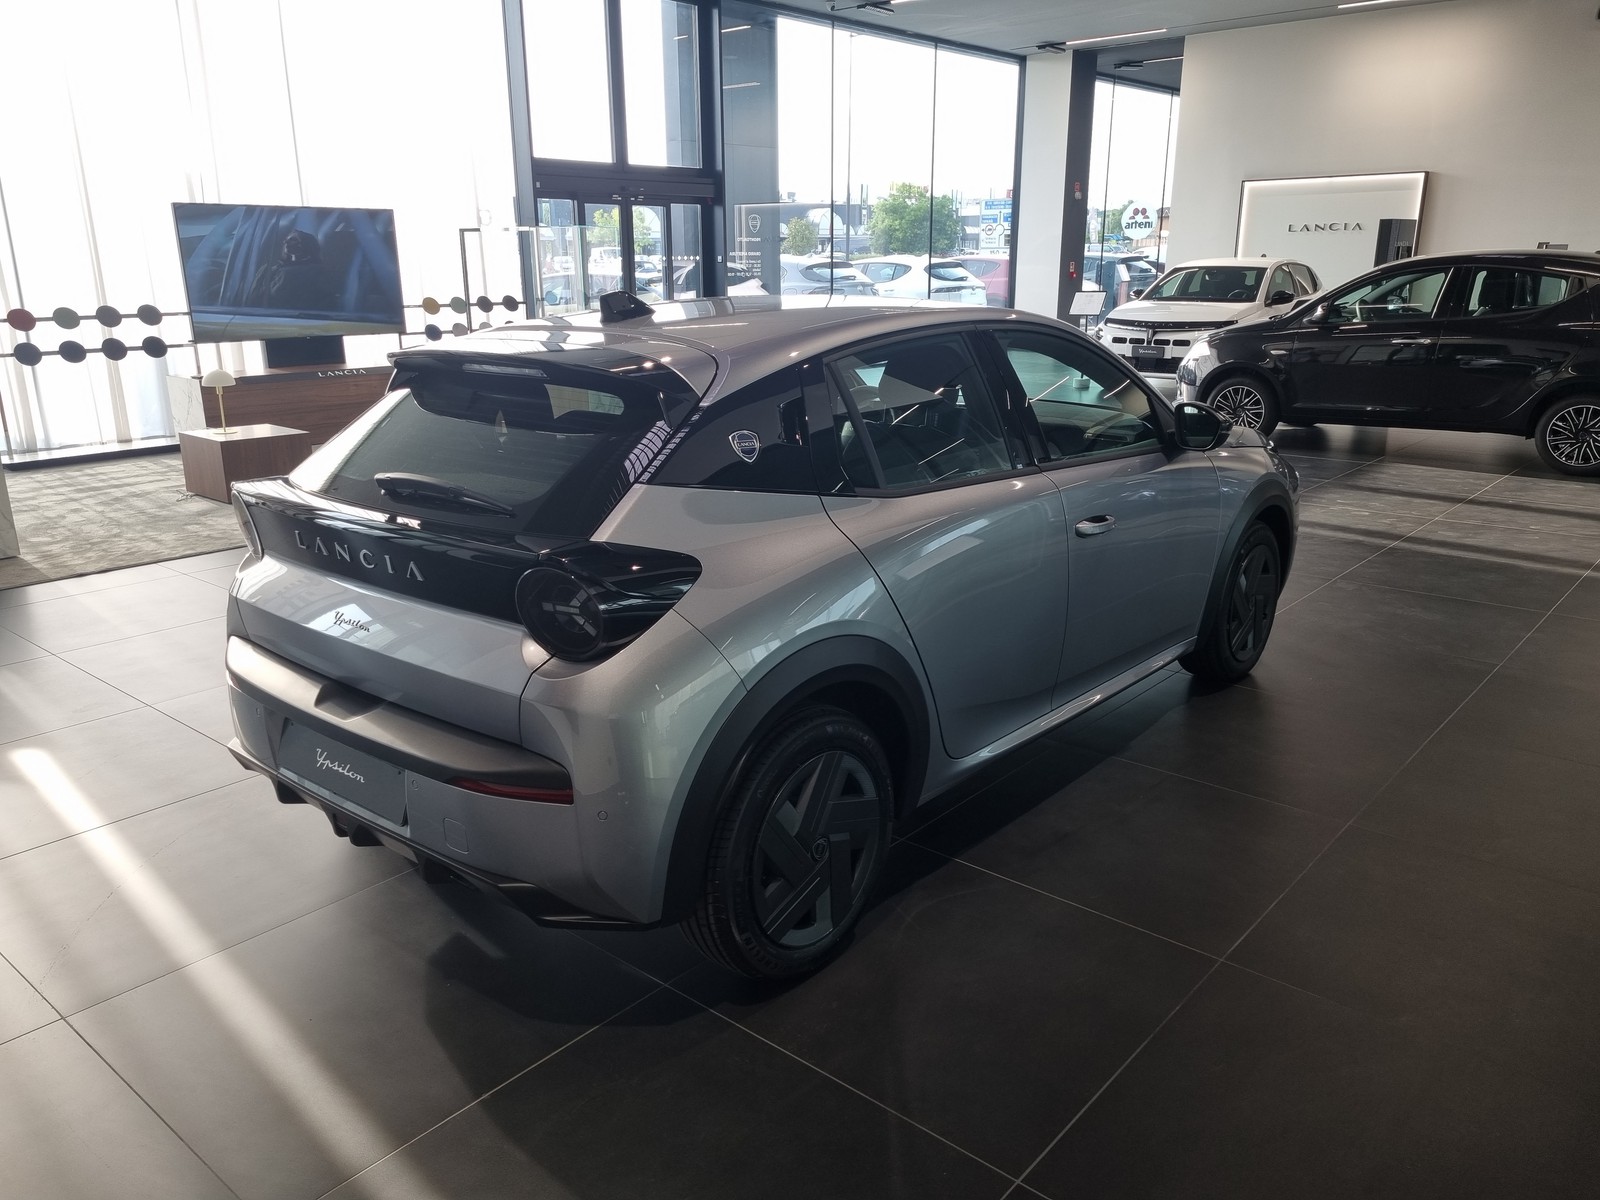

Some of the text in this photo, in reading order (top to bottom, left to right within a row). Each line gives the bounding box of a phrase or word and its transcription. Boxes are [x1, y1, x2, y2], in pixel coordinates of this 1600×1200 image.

[1124, 220, 1153, 230] arteni
[1287, 222, 1363, 233] LANCIA
[317, 368, 367, 378] LANCIA
[294, 530, 423, 582] LANCIA
[333, 610, 371, 633] Ypsilon
[316, 748, 365, 783] Ypsilon
